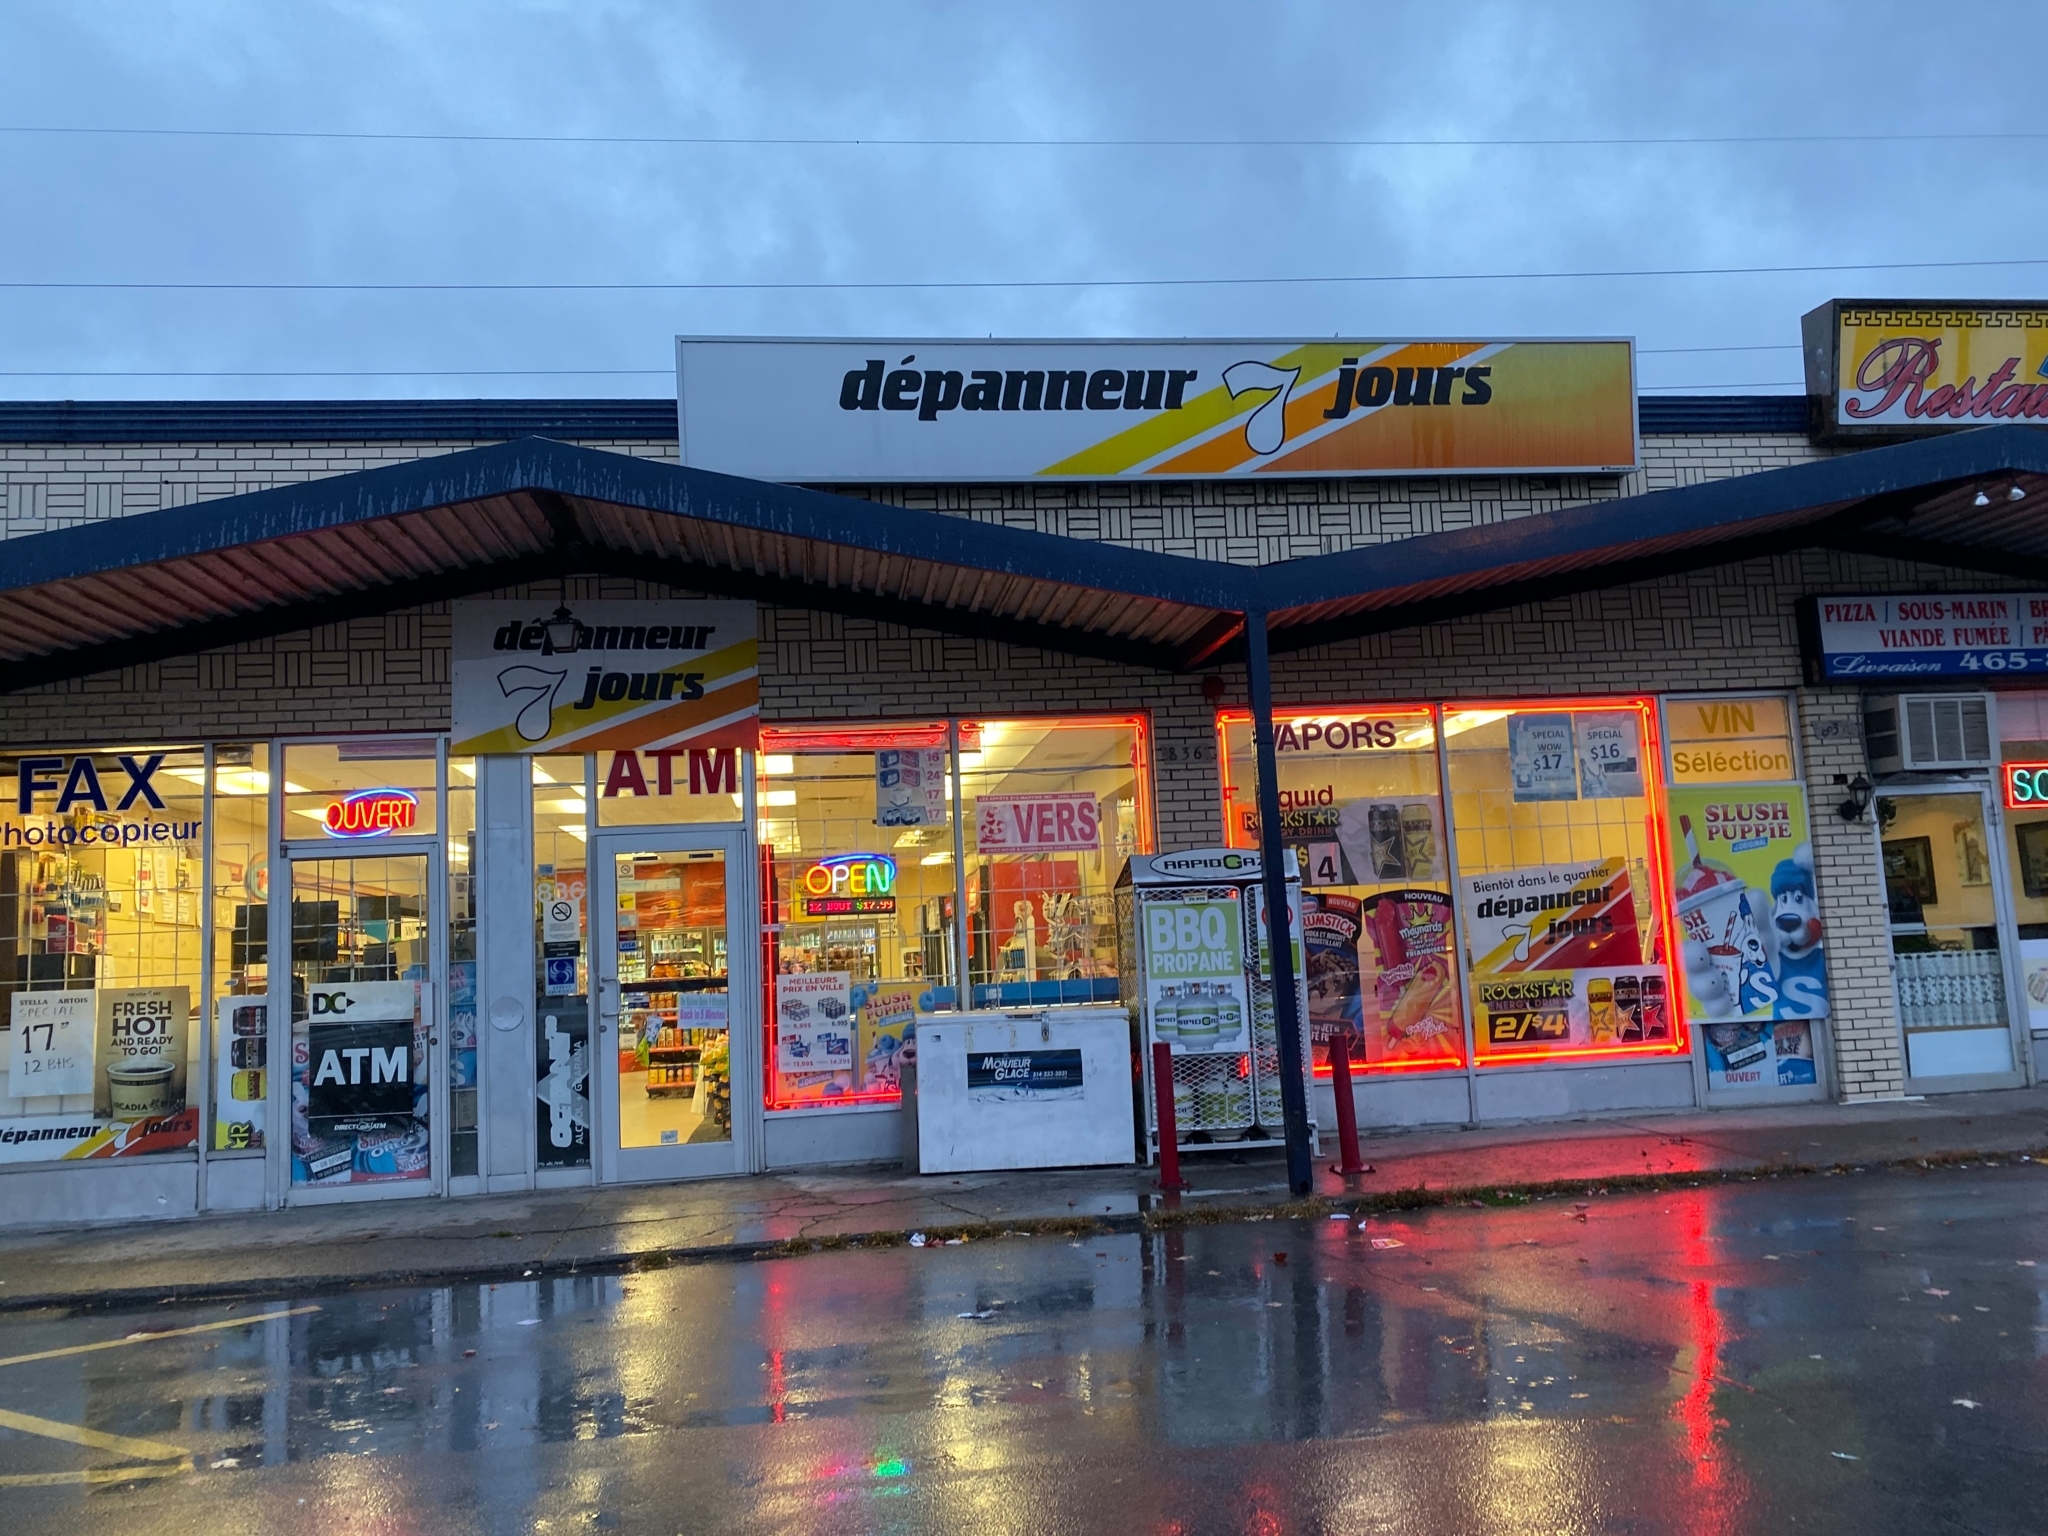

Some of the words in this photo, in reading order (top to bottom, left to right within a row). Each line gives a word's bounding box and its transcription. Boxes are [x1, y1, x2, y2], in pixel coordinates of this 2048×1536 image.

[839, 355, 1198, 421] dépanneur
[1222, 361, 1301, 455] 7
[1323, 358, 1492, 419] jours
[1824, 604, 1877, 622] PIZZA
[1898, 600, 2009, 621] SOUS-MARIN
[1879, 629, 1946, 648] VIANDE
[1953, 621, 2011, 646] FUMÉE
[1833, 655, 1942, 675] Livraison
[497, 665, 568, 741] 7
[573, 667, 705, 709] jours
[1697, 705, 1755, 734] VIN
[1532, 730, 1565, 740] SPECIAL
[1587, 730, 1623, 740] SPECIAL
[1169, 746, 1203, 760] 836
[1537, 743, 1562, 751] WOW
[1591, 743, 1620, 762] $16
[1534, 754, 1562, 772] $17
[1673, 751, 1790, 774] Séléction
[18, 753, 167, 815] FAX
[602, 749, 737, 798] ATM
[325, 800, 414, 831] OUVERT
[1012, 801, 1097, 844] VERS
[1705, 803, 1790, 823] SLUSH
[0, 818, 202, 848] hotocopieur
[806, 863, 890, 894] OPEN
[1473, 877, 1514, 893] Bientôt
[1518, 873, 1546, 888] dans
[1550, 871, 1560, 884] le
[1564, 867, 1610, 883] quartier
[537, 881, 586, 902] 836
[1404, 892, 1443, 903] NOUVEAU
[1477, 885, 1614, 919] dépanneur
[1328, 897, 1356, 909] NOUVEAU
[1151, 907, 1227, 951] BBQ
[1303, 913, 1355, 938] RUMSTICK
[1399, 921, 1443, 940] Maynards
[1501, 924, 1533, 962] 7
[1544, 914, 1614, 945] jours
[1153, 951, 1234, 974] PROPANE
[782, 985, 803, 993] PRIX
[805, 984, 818, 992] EN
[820, 983, 844, 991] VILLE
[789, 976, 838, 985] MEILLEURS
[1750, 971, 1778, 1009] S
[312, 992, 346, 1015] DC
[864, 991, 912, 1010] SLUSH
[1779, 976, 1829, 1020] S
[19, 1005, 75, 1018] SPECIAL
[112, 1016, 172, 1036] HOT
[111, 1037, 135, 1047] AND
[137, 1036, 173, 1046] READY
[122, 1047, 138, 1056] TO
[140, 1046, 162, 1056] GO!
[25, 1060, 42, 1075] 12
[313, 1046, 408, 1087] ATM
[982, 1056, 1032, 1070] MONSIEUR
[995, 1067, 1030, 1081] GLACE
[1725, 1071, 1761, 1083] OUVERT
[108, 1121, 133, 1149] 7
[140, 1119, 192, 1138] jours
